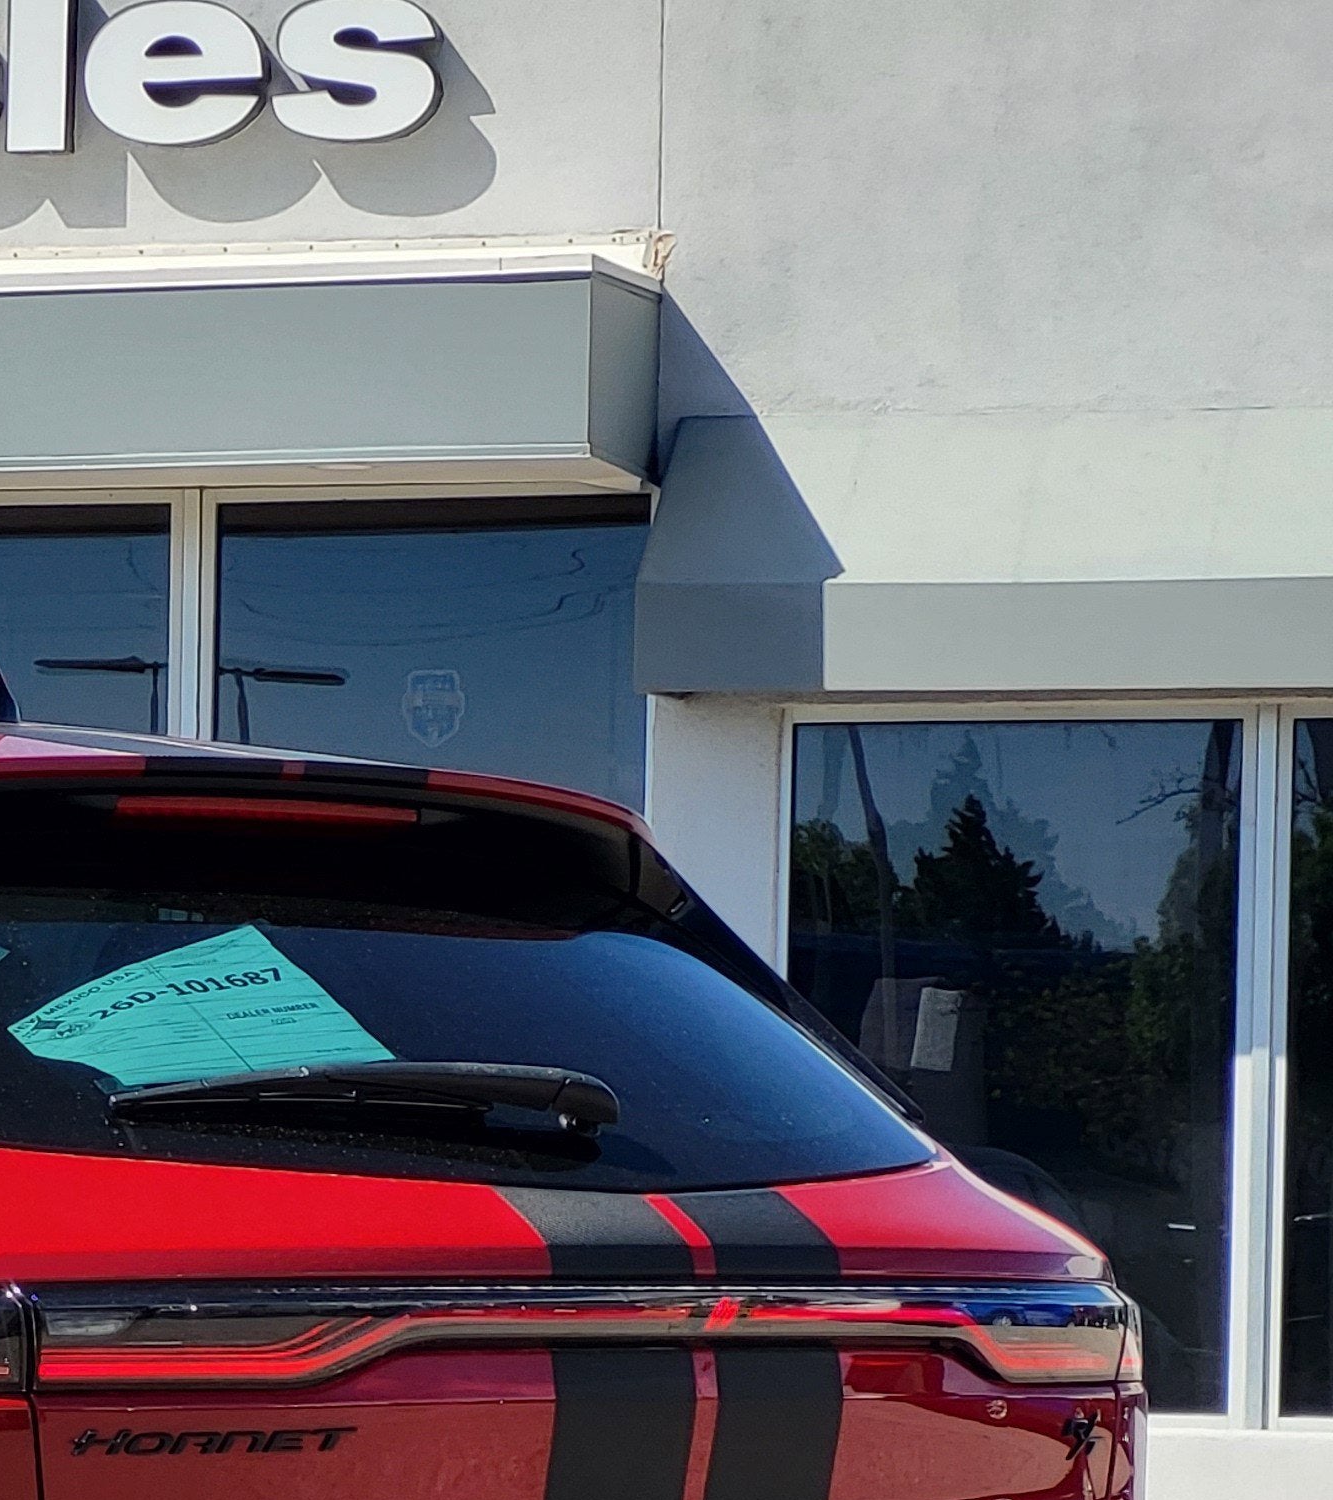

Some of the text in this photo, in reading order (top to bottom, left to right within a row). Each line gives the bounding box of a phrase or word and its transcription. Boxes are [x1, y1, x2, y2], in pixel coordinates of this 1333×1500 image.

[42, 985, 102, 1016] MEXICO
[102, 970, 136, 987] USA
[88, 967, 283, 1021] 26D-101687
[226, 1002, 320, 1020] DEALER NUMBER
[70, 1426, 359, 1457] HORNET
